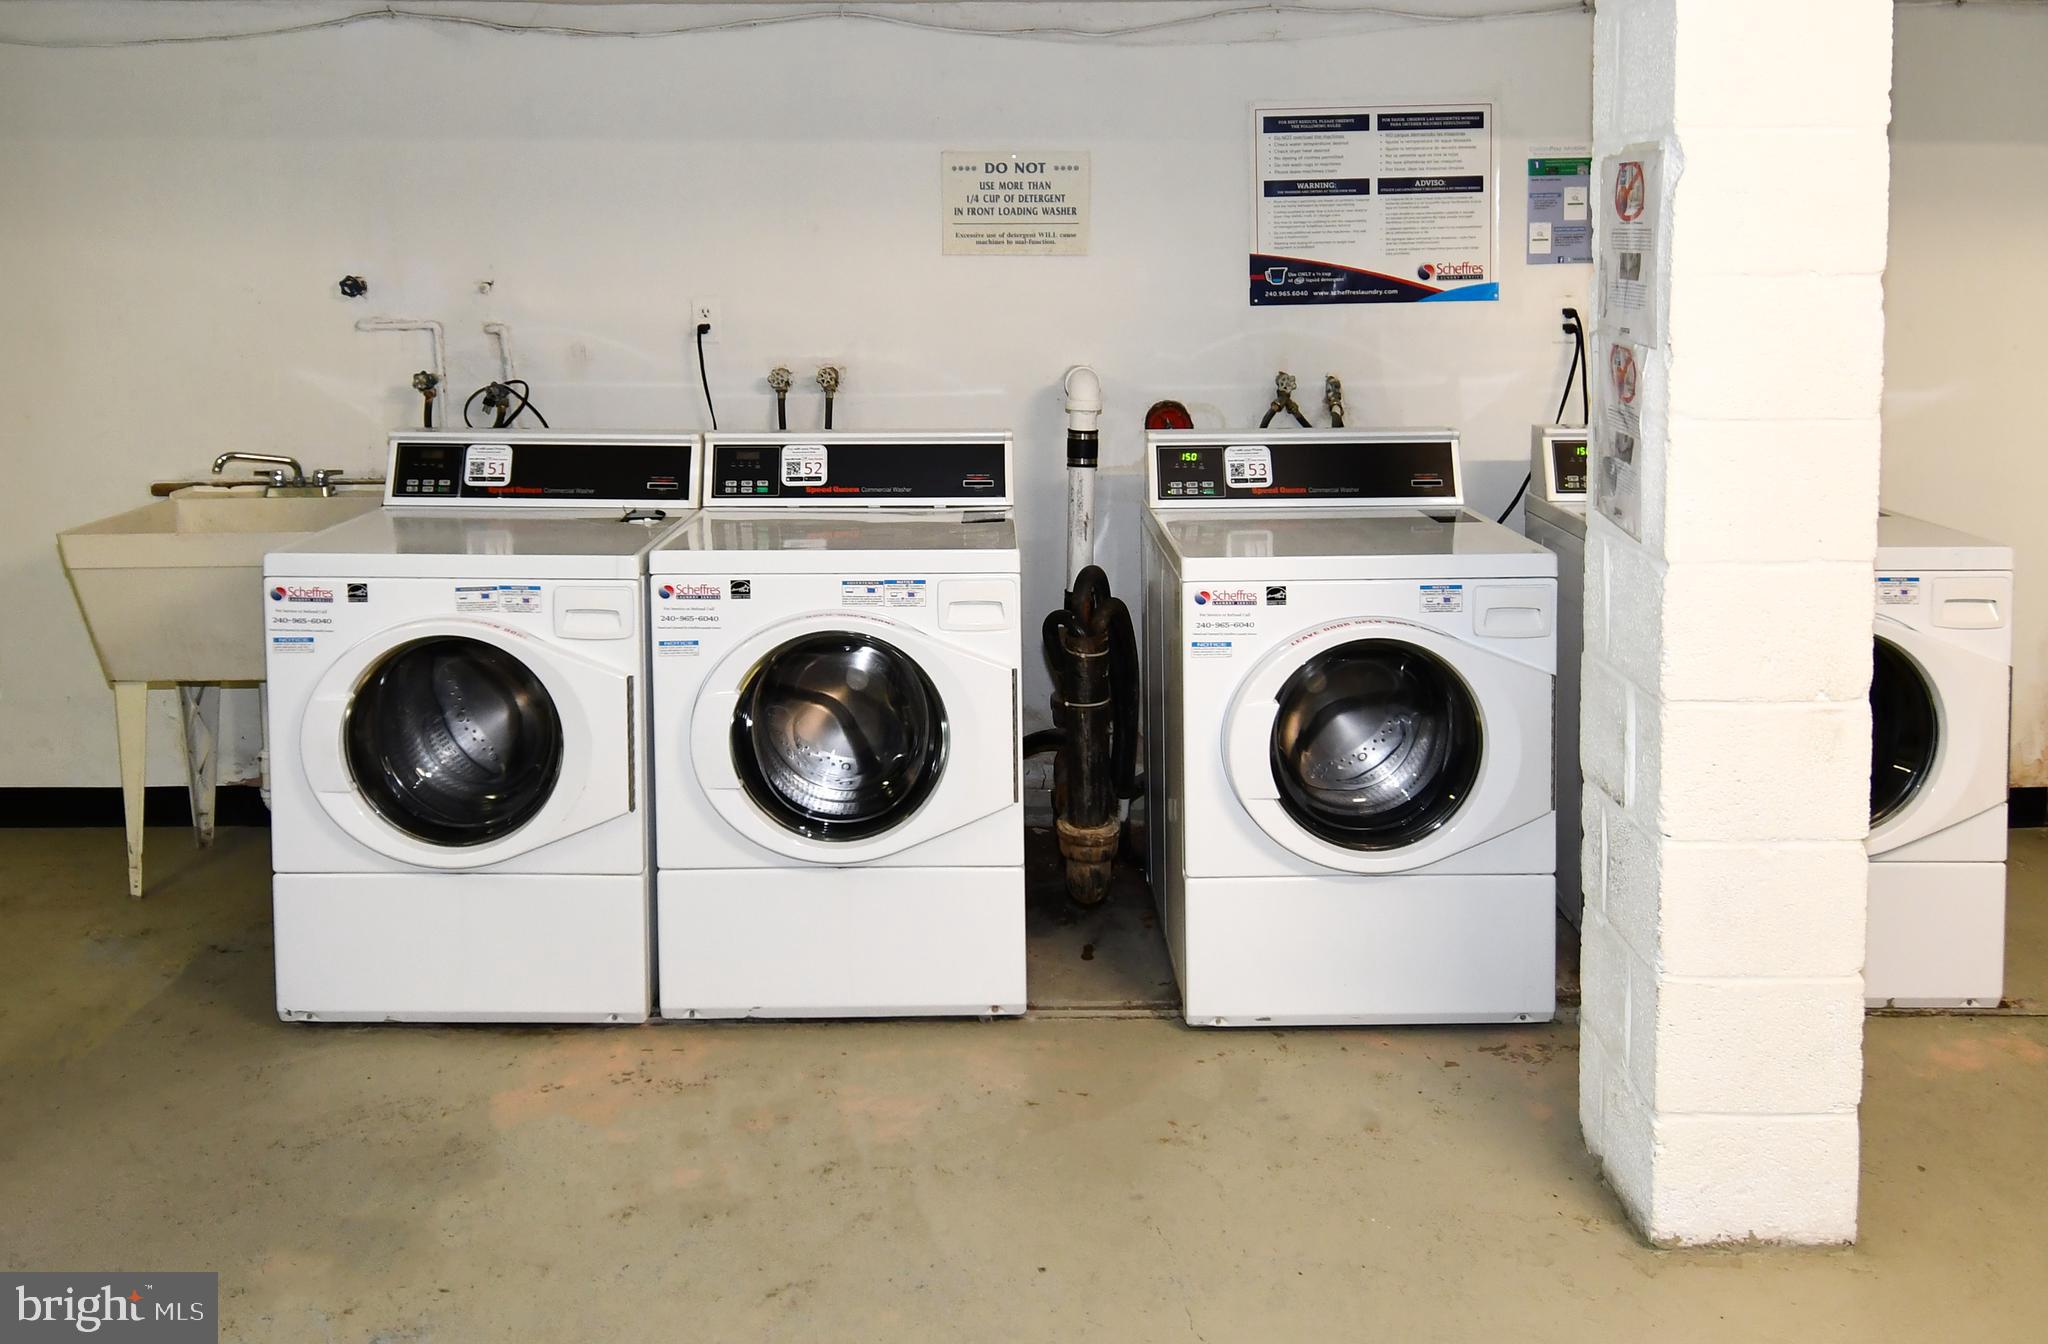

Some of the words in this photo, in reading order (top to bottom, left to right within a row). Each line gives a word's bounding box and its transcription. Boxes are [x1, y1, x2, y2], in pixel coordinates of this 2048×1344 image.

[985, 162, 1008, 174] DO
[1014, 162, 1046, 174] NOT
[980, 182, 994, 190] USE
[998, 182, 1024, 190] MORE
[1028, 182, 1051, 190] THAN
[966, 194, 979, 203] 1/4
[984, 194, 1000, 202] CUP
[1004, 194, 1014, 202] OF
[1018, 194, 1065, 202] DETERGENT
[954, 207, 963, 215] IN
[967, 207, 994, 215] FRONT
[998, 207, 1038, 215] LOADING
[1042, 207, 1077, 215] WASHER
[1436, 261, 1483, 274] Scheffres
[1182, 453, 1198, 461] 150
[488, 462, 506, 475] 51
[804, 462, 822, 475] 52
[1248, 464, 1267, 476] 53
[288, 586, 333, 598] Scheffres
[676, 584, 721, 595] Scheffres
[1212, 590, 1257, 600] Scheffres
[1291, 631, 1320, 646] LEAVE
[1324, 622, 1351, 631] DOOR
